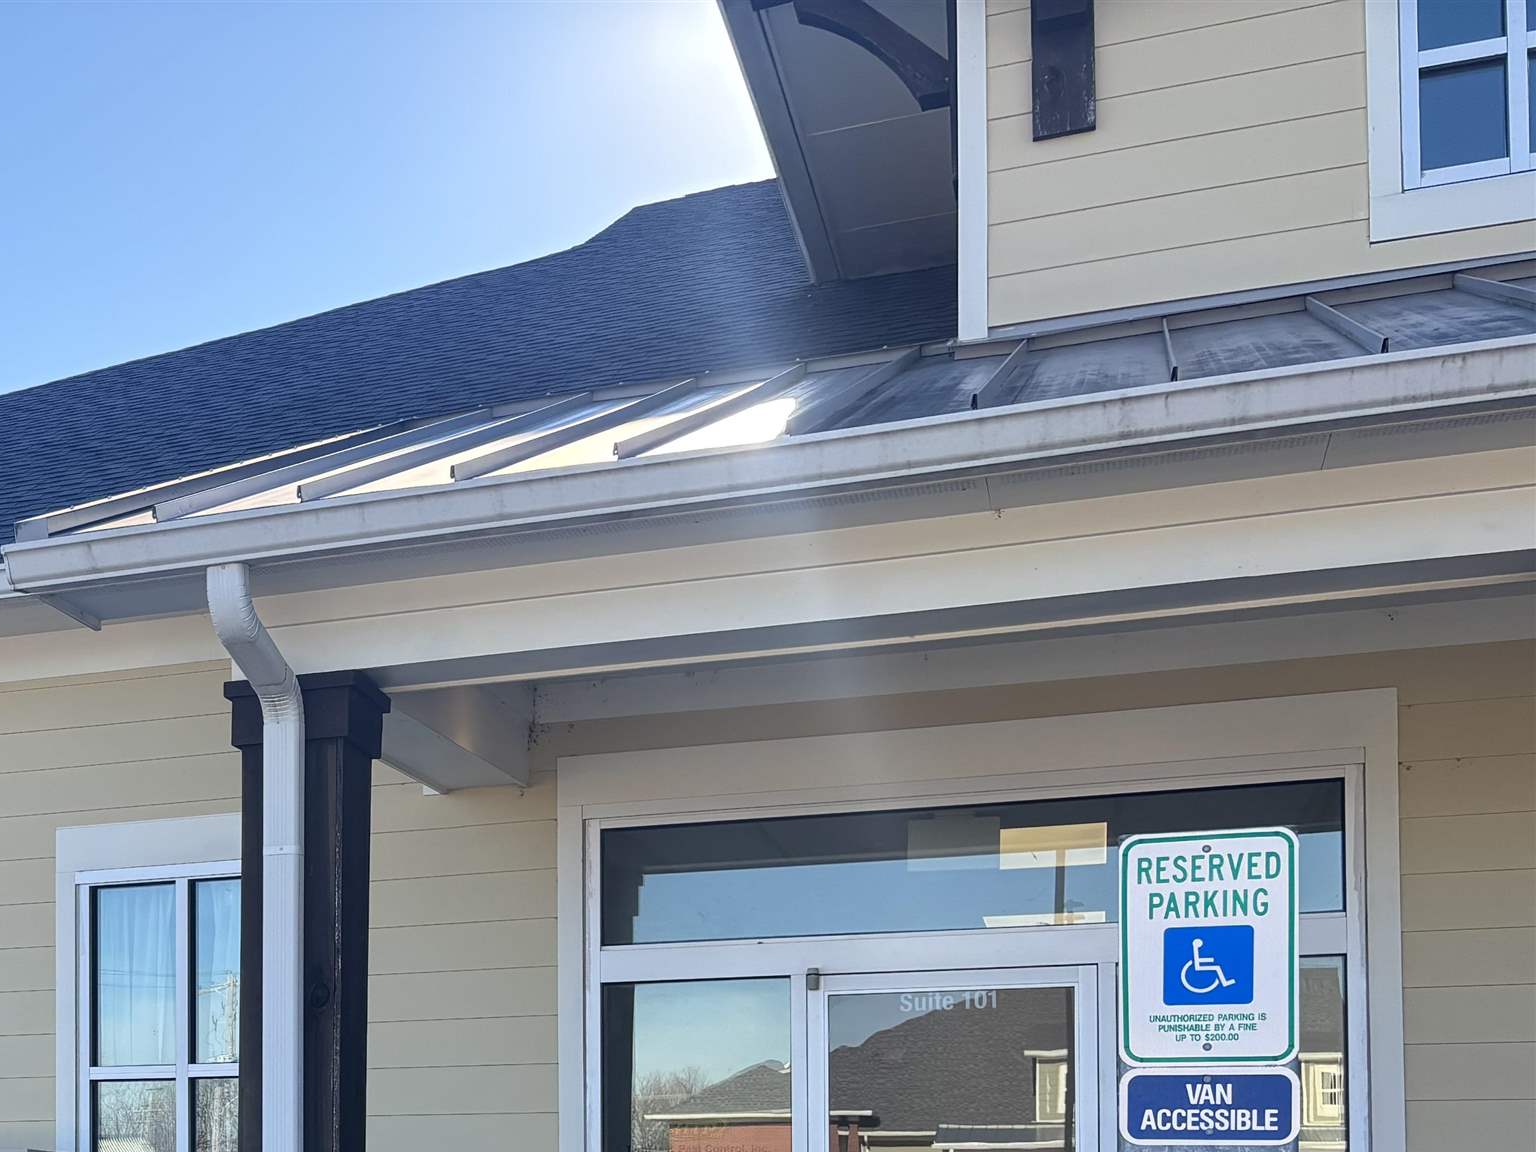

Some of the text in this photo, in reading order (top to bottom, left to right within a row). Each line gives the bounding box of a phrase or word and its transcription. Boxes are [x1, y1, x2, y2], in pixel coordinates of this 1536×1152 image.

[1137, 851, 1281, 885] RESERVED
[1148, 888, 1269, 920] PARKING
[899, 990, 997, 1012] Suite 101
[1149, 1012, 1268, 1023] UNAUTHORIZED PARKING IS
[1158, 1022, 1258, 1032] PUNISHABLE BY A FINE
[1175, 1033, 1240, 1042] UP TO $200.00
[1185, 1083, 1233, 1105] VAN
[1140, 1108, 1279, 1131] ACCESSIBLE
